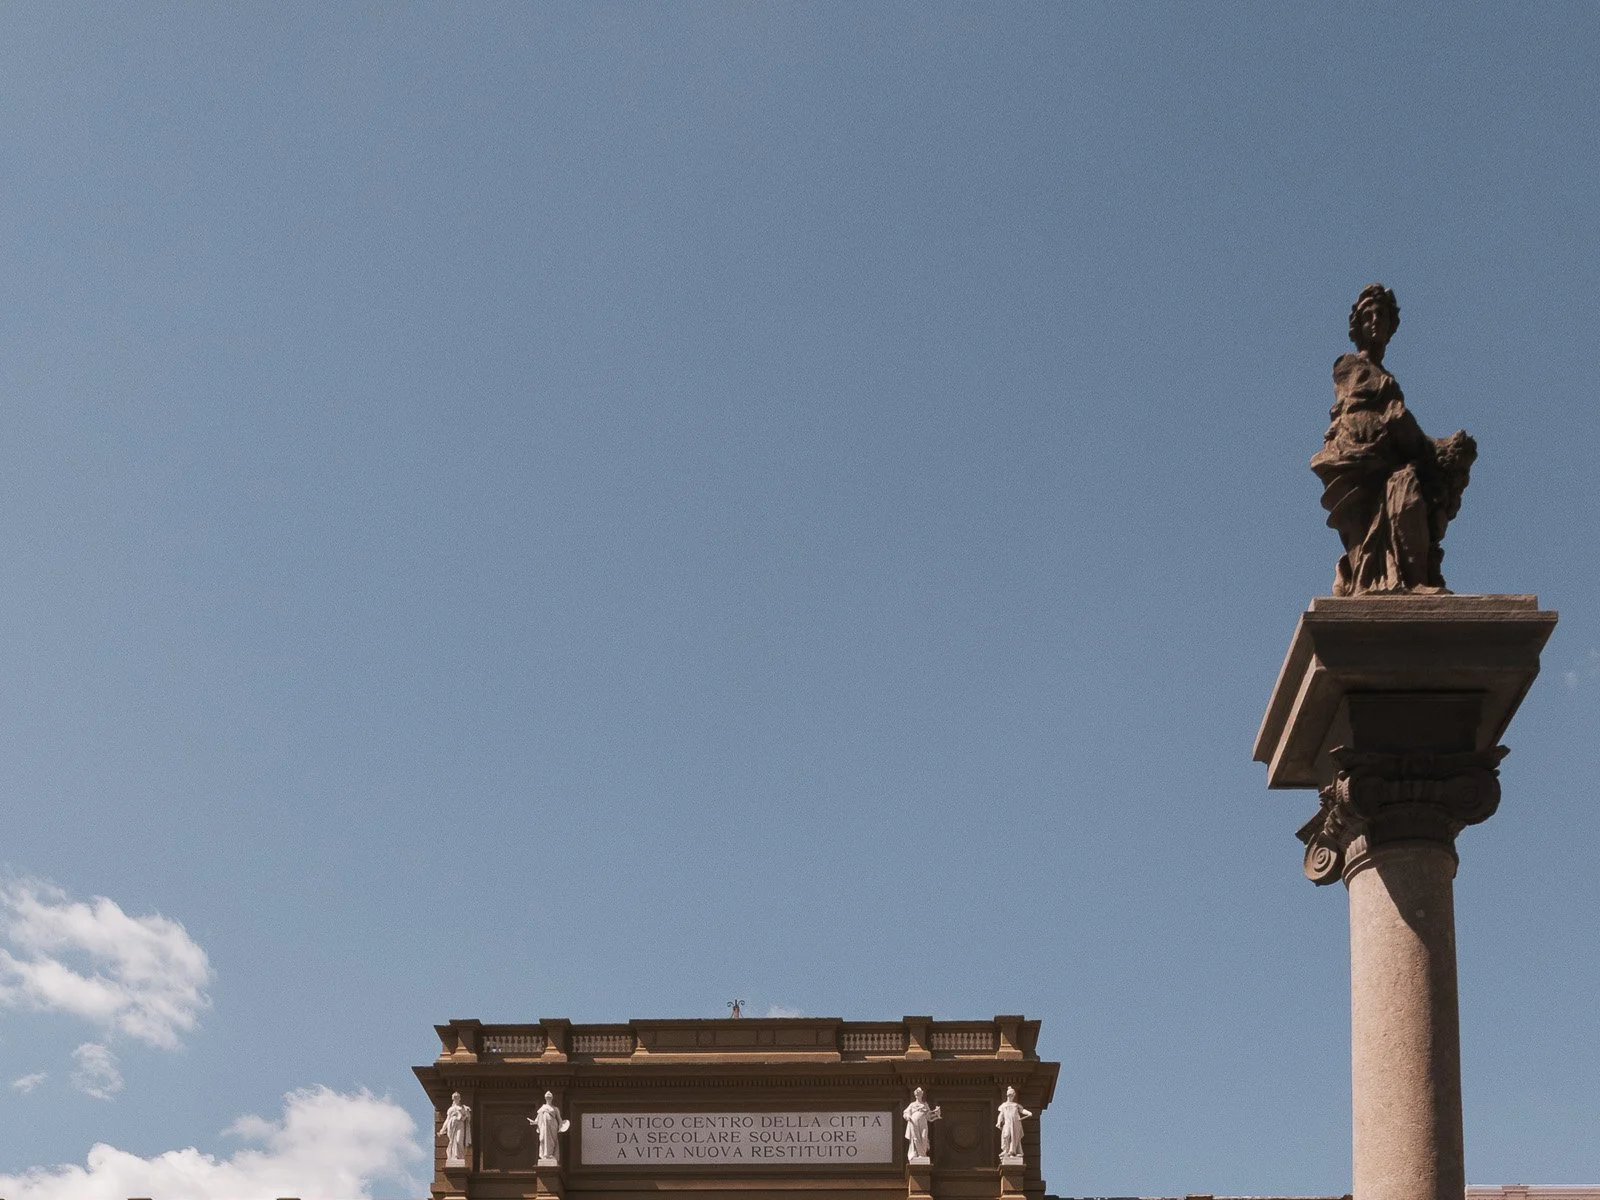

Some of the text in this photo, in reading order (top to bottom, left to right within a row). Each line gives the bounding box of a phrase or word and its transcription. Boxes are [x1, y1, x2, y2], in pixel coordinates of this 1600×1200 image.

[611, 1116, 675, 1129] ANTICO
[681, 1116, 754, 1129] CENTRO
[761, 1115, 822, 1128] DELLA
[616, 1130, 858, 1144] DA SECOLARE SQUALLORE
[616, 1145, 858, 1159] A VITA NUOVA RESTITUITO
